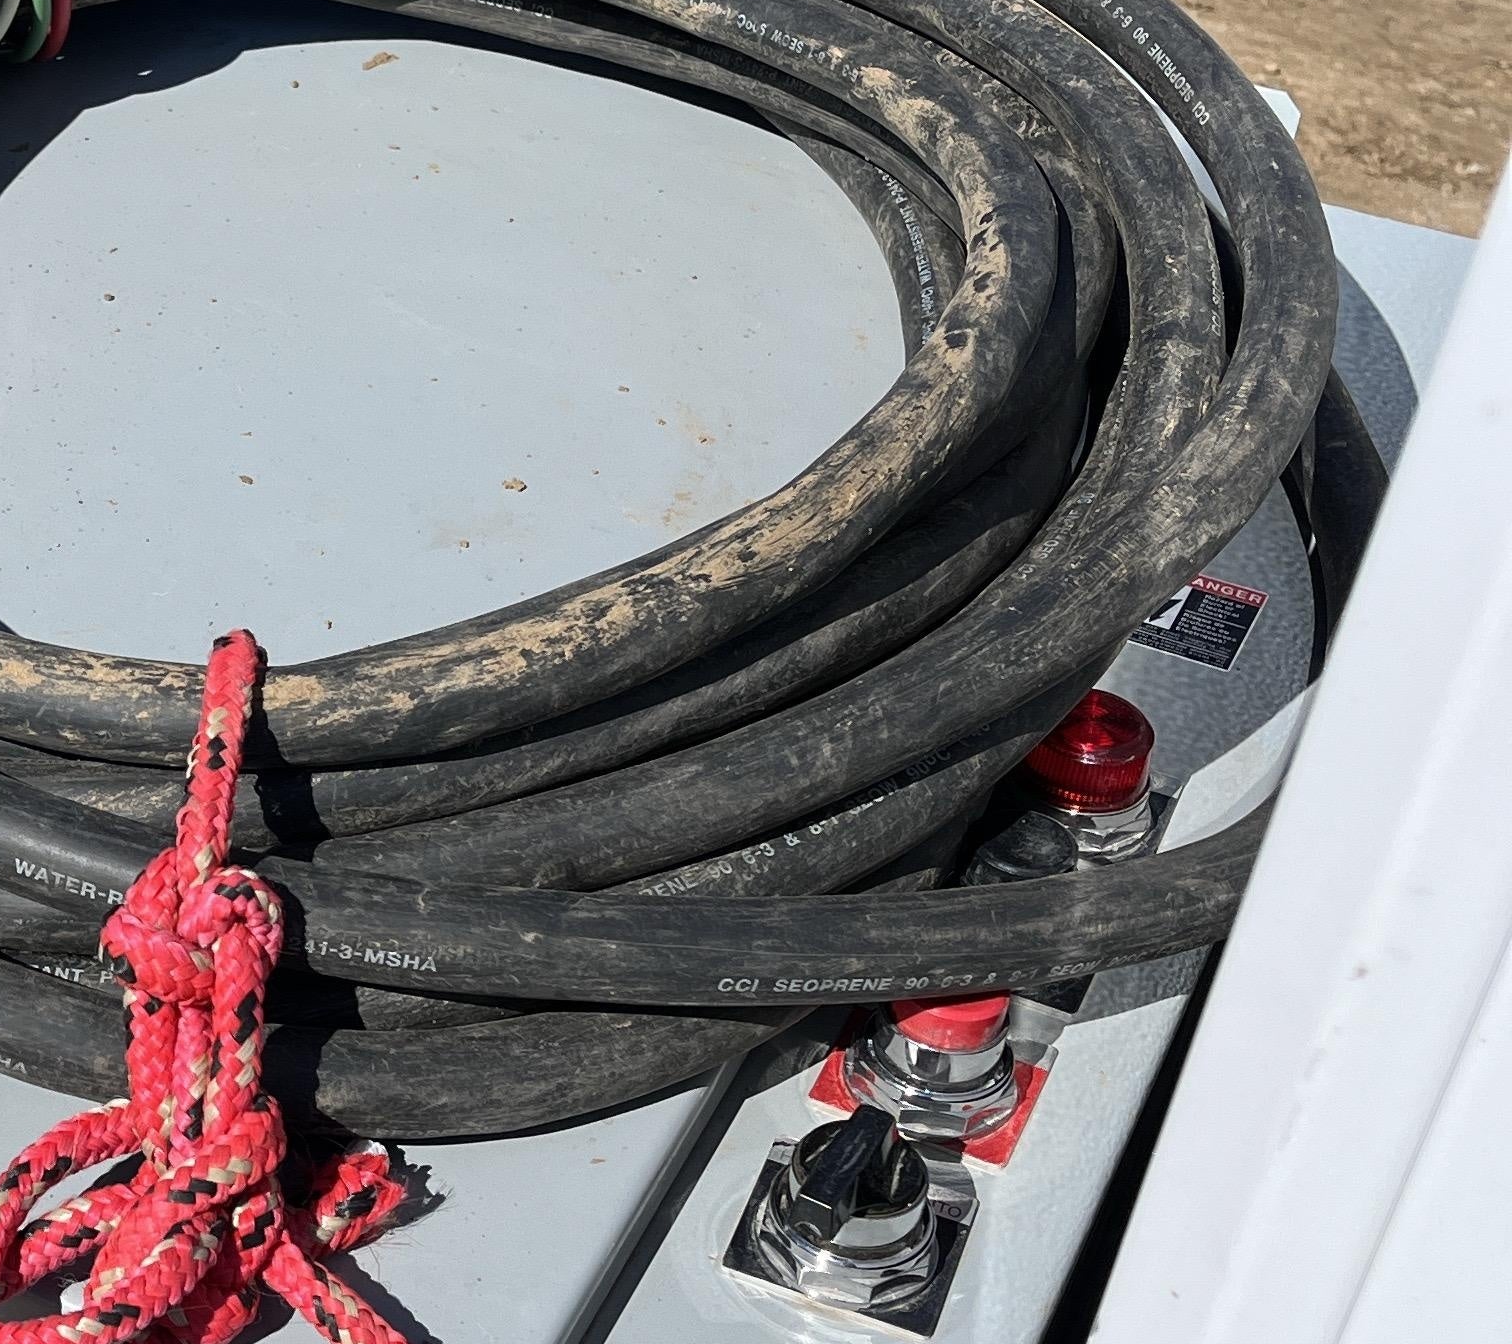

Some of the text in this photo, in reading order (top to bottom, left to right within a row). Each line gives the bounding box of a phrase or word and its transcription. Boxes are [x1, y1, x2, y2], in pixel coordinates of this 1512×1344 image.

[1110, 3, 1134, 28] 6-3
[769, 28, 806, 55] SEOW
[1132, 26, 1150, 45] 90
[1145, 41, 1197, 104] SEOPRENE
[1191, 103, 1210, 127] CCI
[1191, 577, 1263, 604] ANGER
[742, 842, 776, 867] 6-3
[783, 831, 801, 849] &
[304, 939, 438, 974] 41-3-MSHA
[717, 977, 760, 993] CCI
[772, 975, 892, 994] SEOPRENE
[903, 975, 930, 991] 90
[931, 1200, 962, 1218] TO
